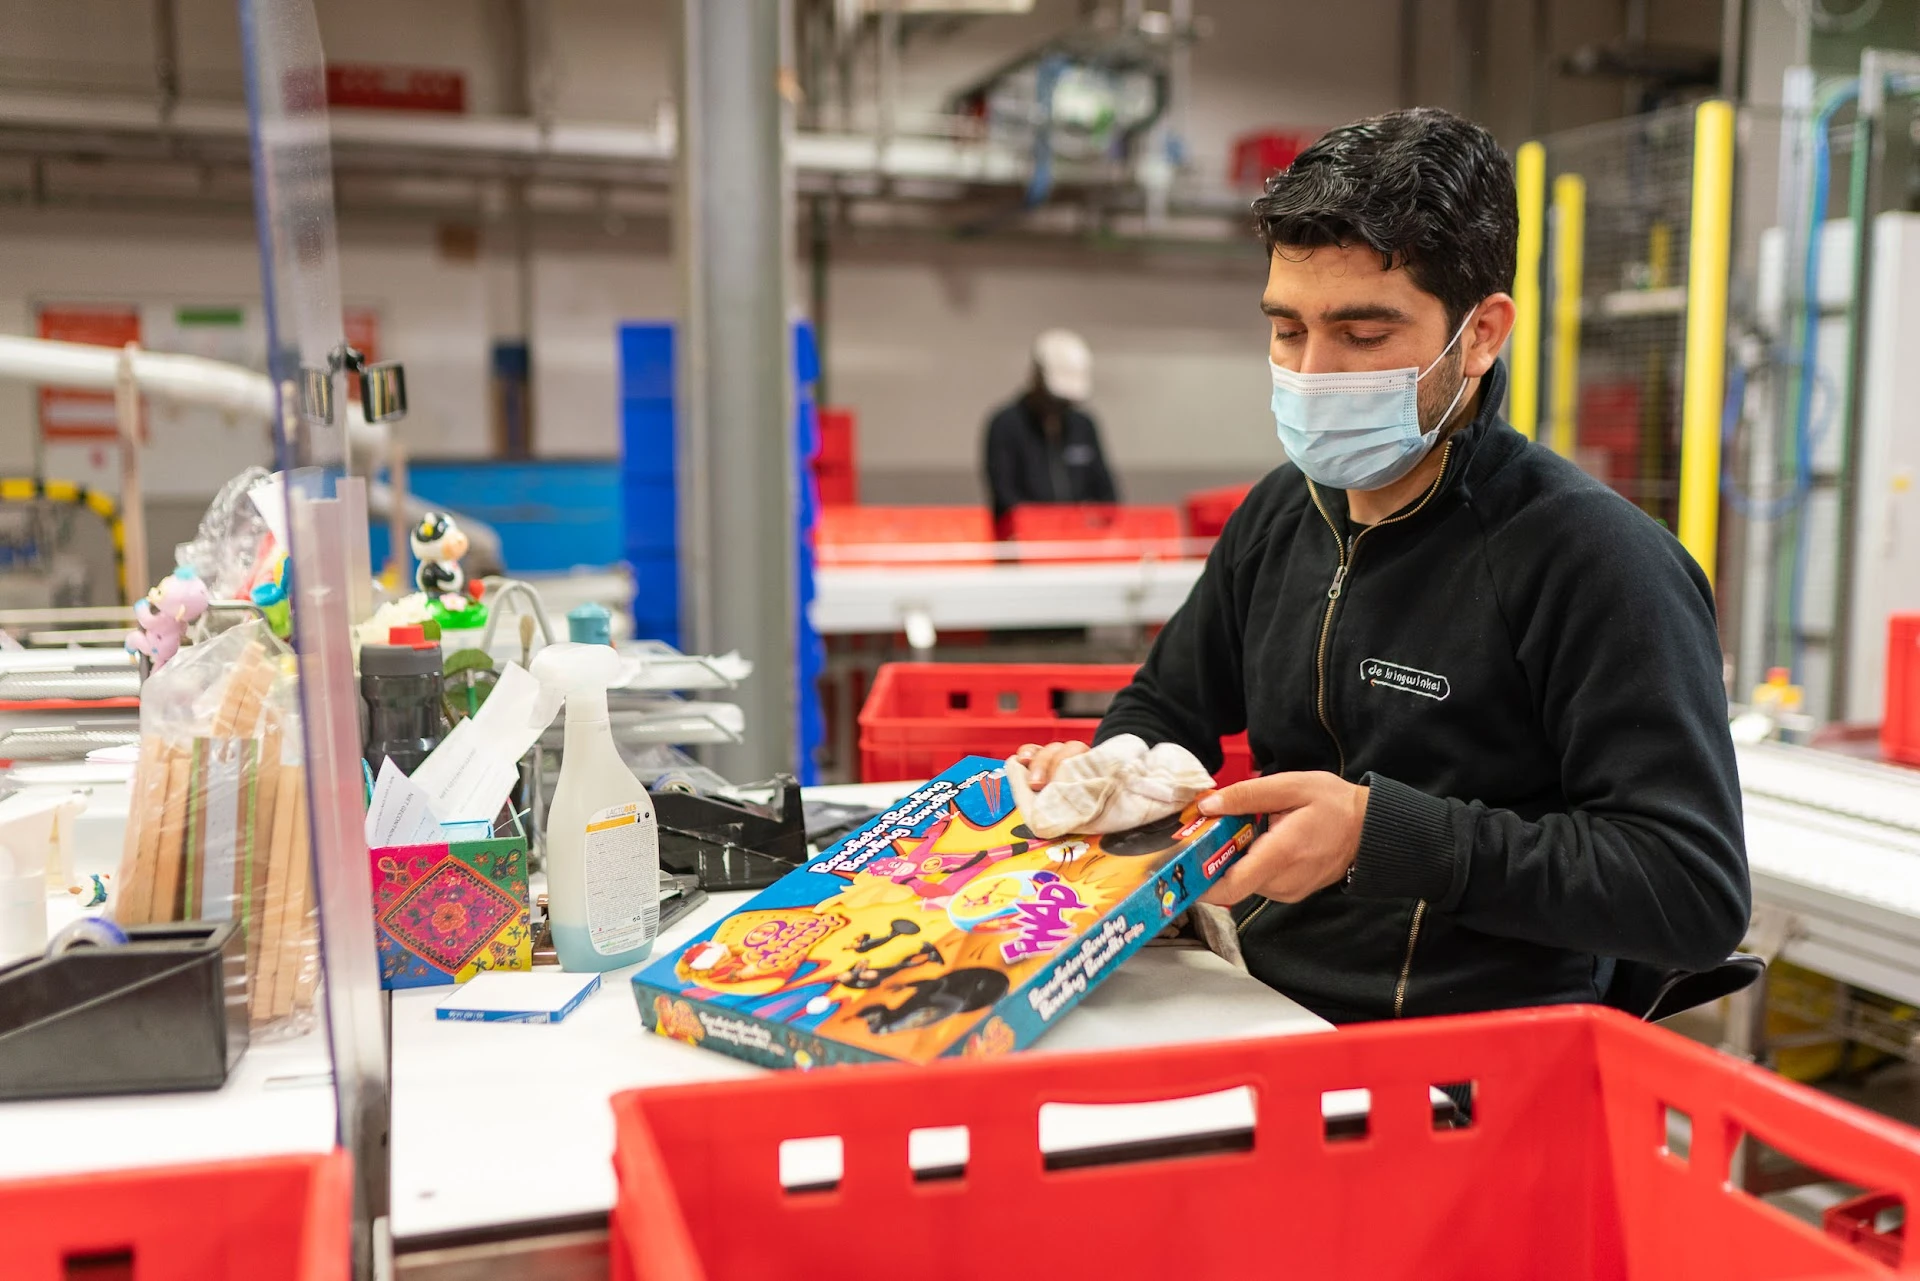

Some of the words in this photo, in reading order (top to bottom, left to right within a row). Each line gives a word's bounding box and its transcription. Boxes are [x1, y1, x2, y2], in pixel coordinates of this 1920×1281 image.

[1368, 664, 1382, 677] de
[834, 827, 912, 872] Bowling
[896, 786, 960, 827] Bandits
[1207, 844, 1236, 876] STUDIO
[1237, 829, 1252, 846] 100
